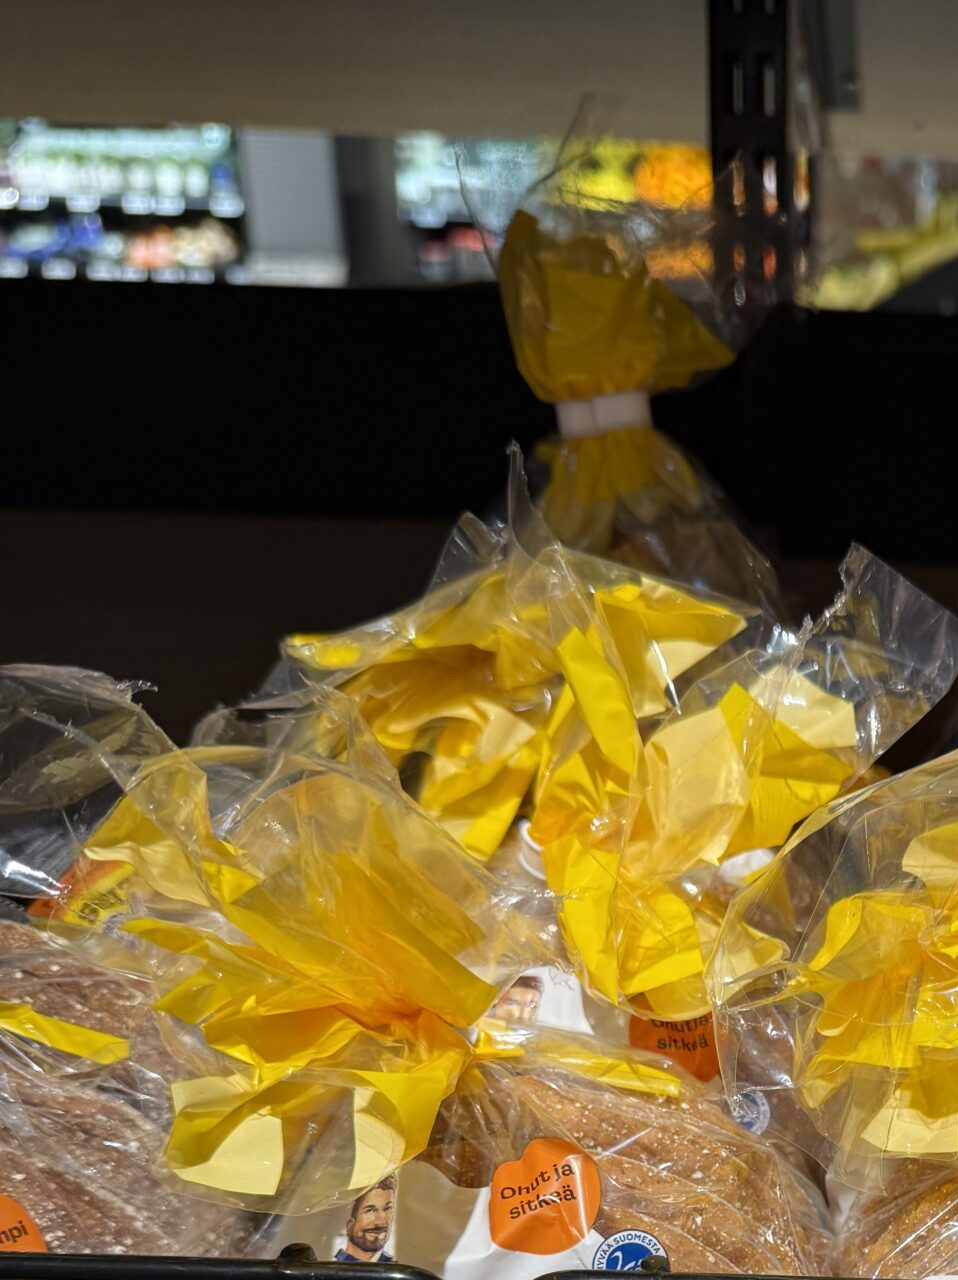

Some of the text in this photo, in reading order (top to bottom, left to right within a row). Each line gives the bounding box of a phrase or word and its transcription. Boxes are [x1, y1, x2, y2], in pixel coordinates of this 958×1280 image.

[500, 1162, 575, 1200] Ohut ja
[509, 1184, 577, 1220] sitkeä
[613, 1233, 661, 1254] SUOMESTA
